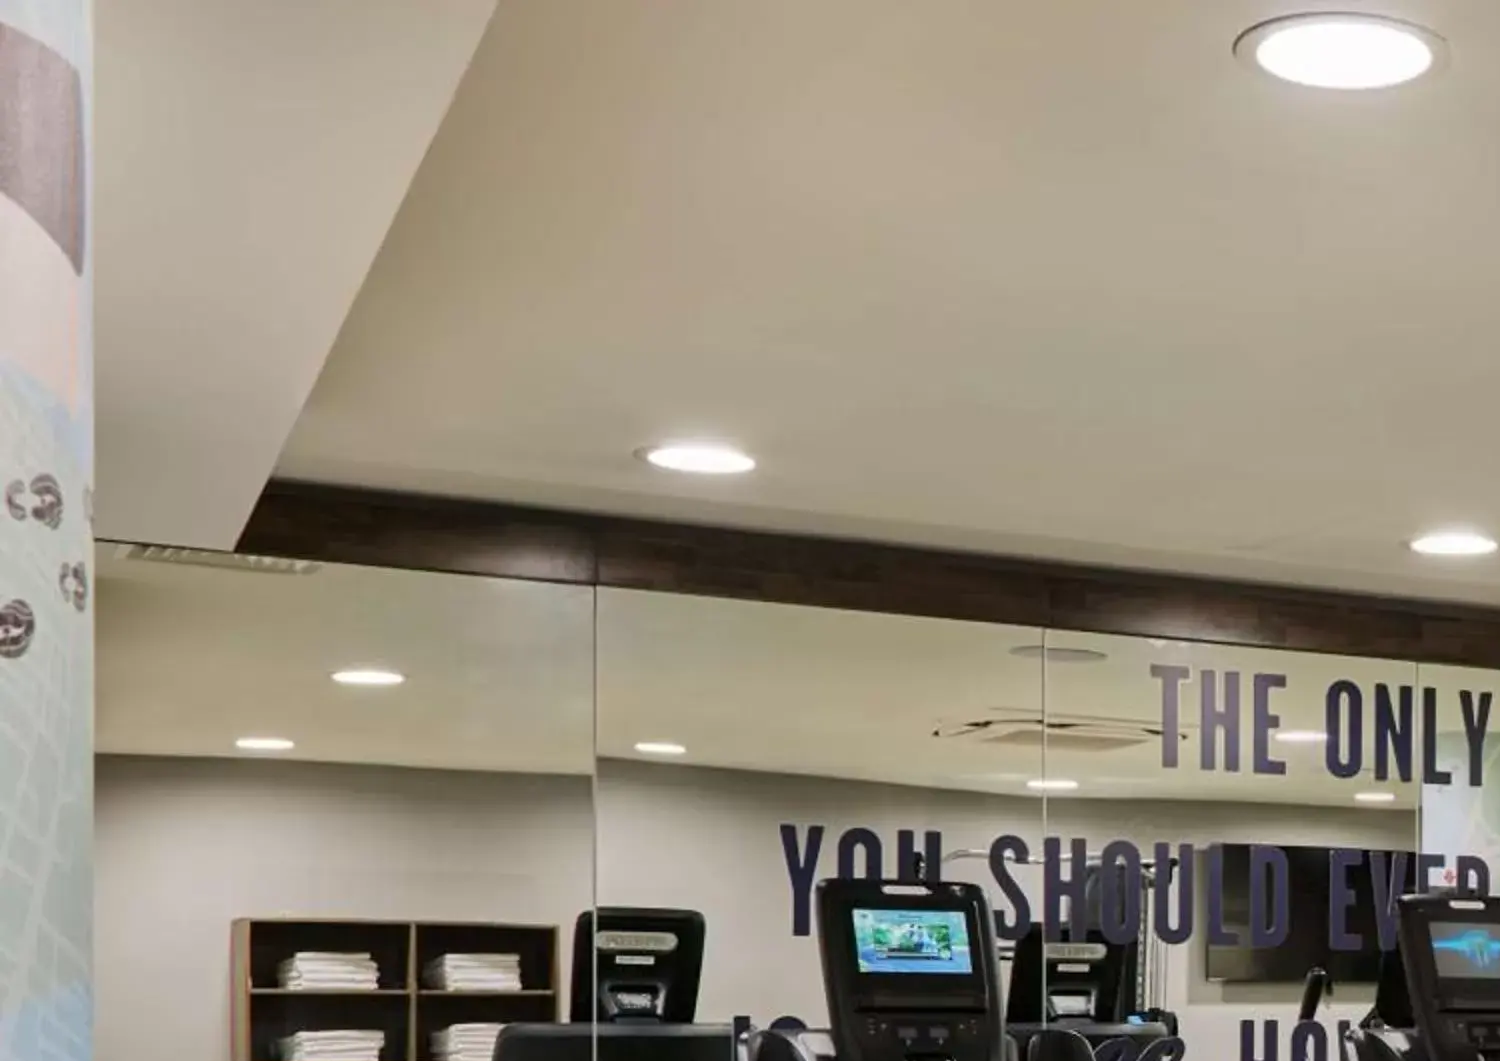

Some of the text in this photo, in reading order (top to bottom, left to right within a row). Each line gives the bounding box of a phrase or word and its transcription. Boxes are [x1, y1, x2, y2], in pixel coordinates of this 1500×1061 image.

[1149, 663, 1287, 775] THE
[1325, 679, 1493, 787] ONLY
[989, 835, 1290, 951] SHOULD
